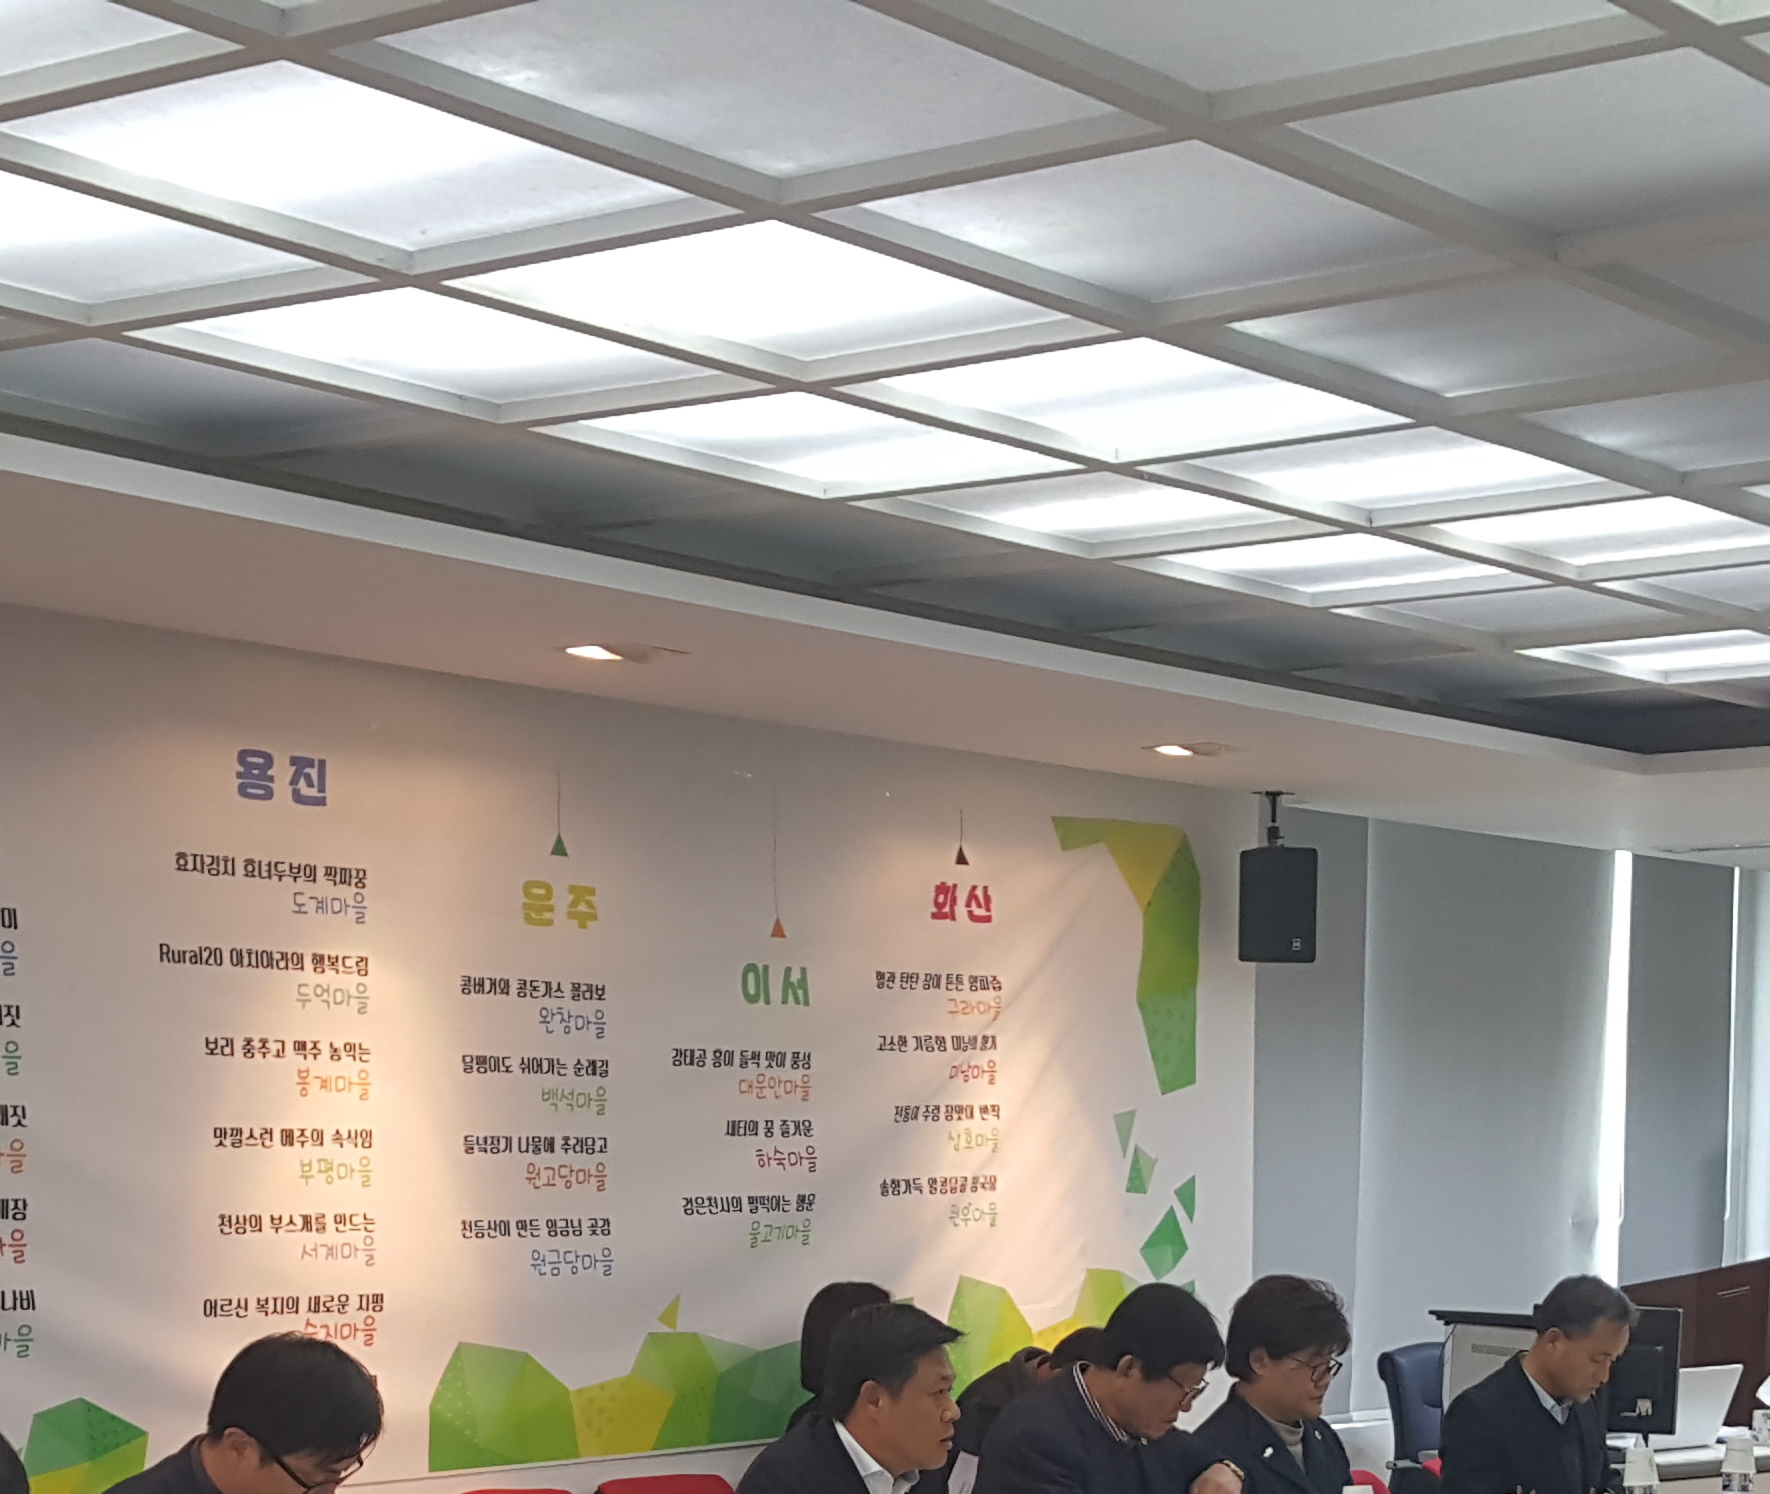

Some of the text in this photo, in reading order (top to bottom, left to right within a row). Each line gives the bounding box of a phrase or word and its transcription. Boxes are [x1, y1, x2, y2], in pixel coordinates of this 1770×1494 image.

[236, 749, 327, 806] 용진
[175, 852, 316, 883] 효자김치 효녀두부의
[292, 892, 367, 924] 도계마을
[522, 880, 598, 929] 운주
[931, 882, 992, 923] 화산
[159, 943, 368, 976] Rural20 아치아라의 행복드림
[296, 983, 369, 1015] 두억마을
[460, 976, 565, 999] 콩버거와 콩돈가스
[741, 963, 810, 1006] 이서
[539, 1007, 606, 1039] 완창마을
[205, 1037, 234, 1057] 보리
[293, 1040, 321, 1060] 맥주
[330, 1042, 371, 1063] 농익는
[672, 1048, 706, 1067] 강태공
[791, 1052, 811, 1070] 풍성
[462, 1055, 608, 1078] 달팽이도 쉬어가는 순례길
[542, 1086, 608, 1116] 백석마을
[214, 1127, 372, 1149] 맛깔스런 메주의 속삭임
[764, 1120, 774, 1138] 꿈
[780, 1120, 813, 1138] 즐거운
[518, 1136, 555, 1155] 나물에
[756, 1145, 817, 1172] 하숙마을
[300, 1156, 373, 1187] 부평마을
[525, 1162, 607, 1192] 원고당마을
[218, 1214, 262, 1235] 천상의
[334, 1213, 375, 1233] 만드는
[461, 1218, 610, 1239] 천등산이 만든 임금님 곶감
[301, 1235, 376, 1267] 서계마을
[530, 1247, 614, 1276] 원금당마을
[1, 1290, 35, 1311] 나비
[204, 1293, 384, 1318] 어르신 복지의 새로운 지평
